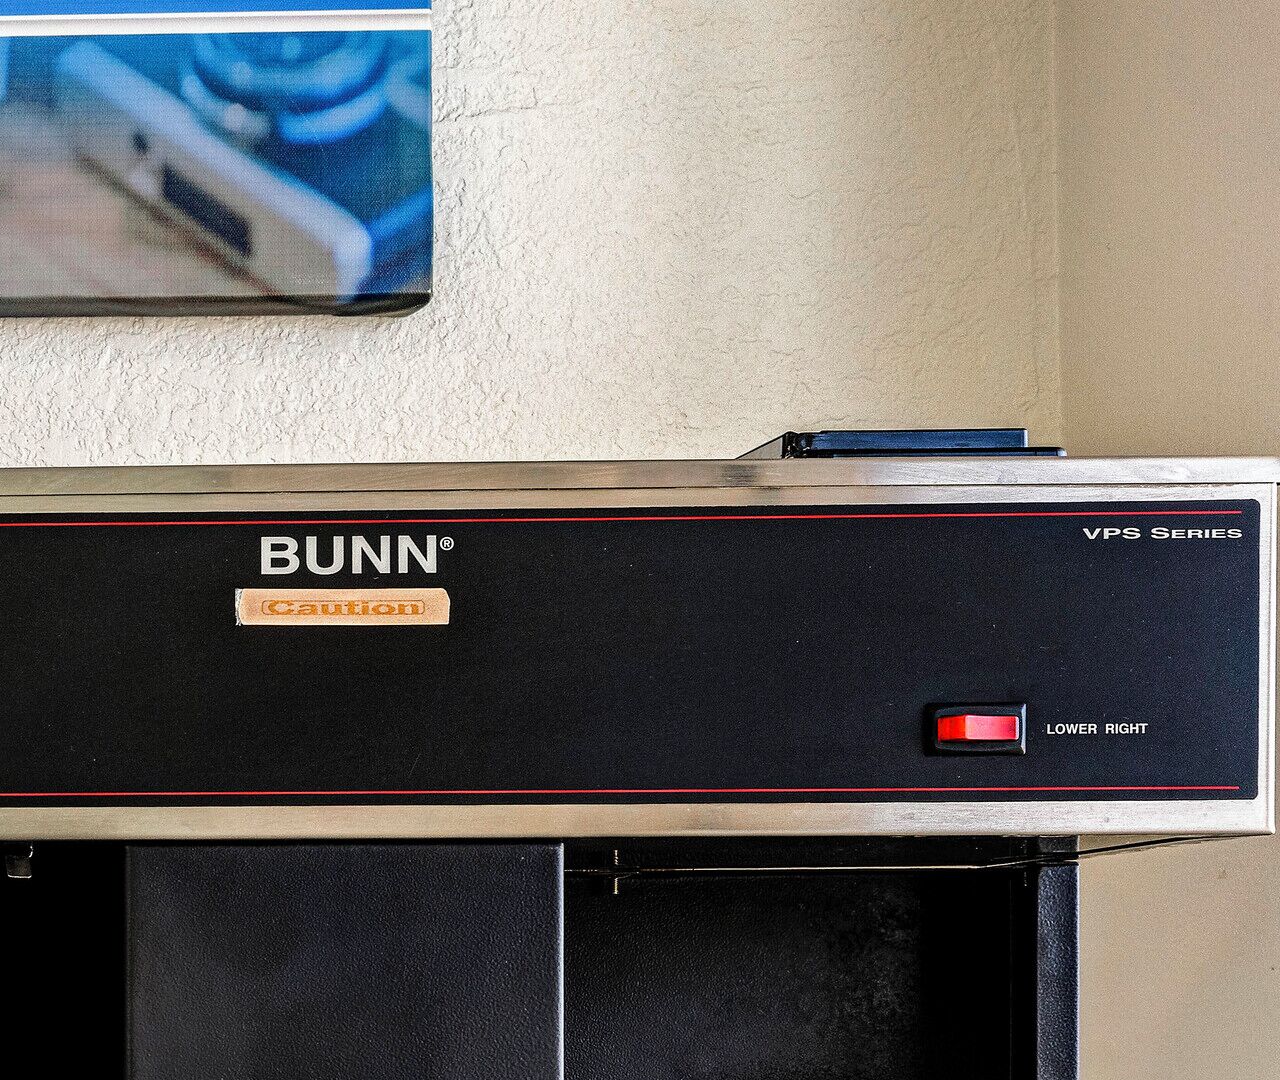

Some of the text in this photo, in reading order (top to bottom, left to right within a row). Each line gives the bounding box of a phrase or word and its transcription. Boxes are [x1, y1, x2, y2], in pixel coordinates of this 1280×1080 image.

[1082, 527, 1141, 540] VPS
[268, 600, 420, 615] Caution
[1046, 723, 1148, 735] LOWER RIGHT
